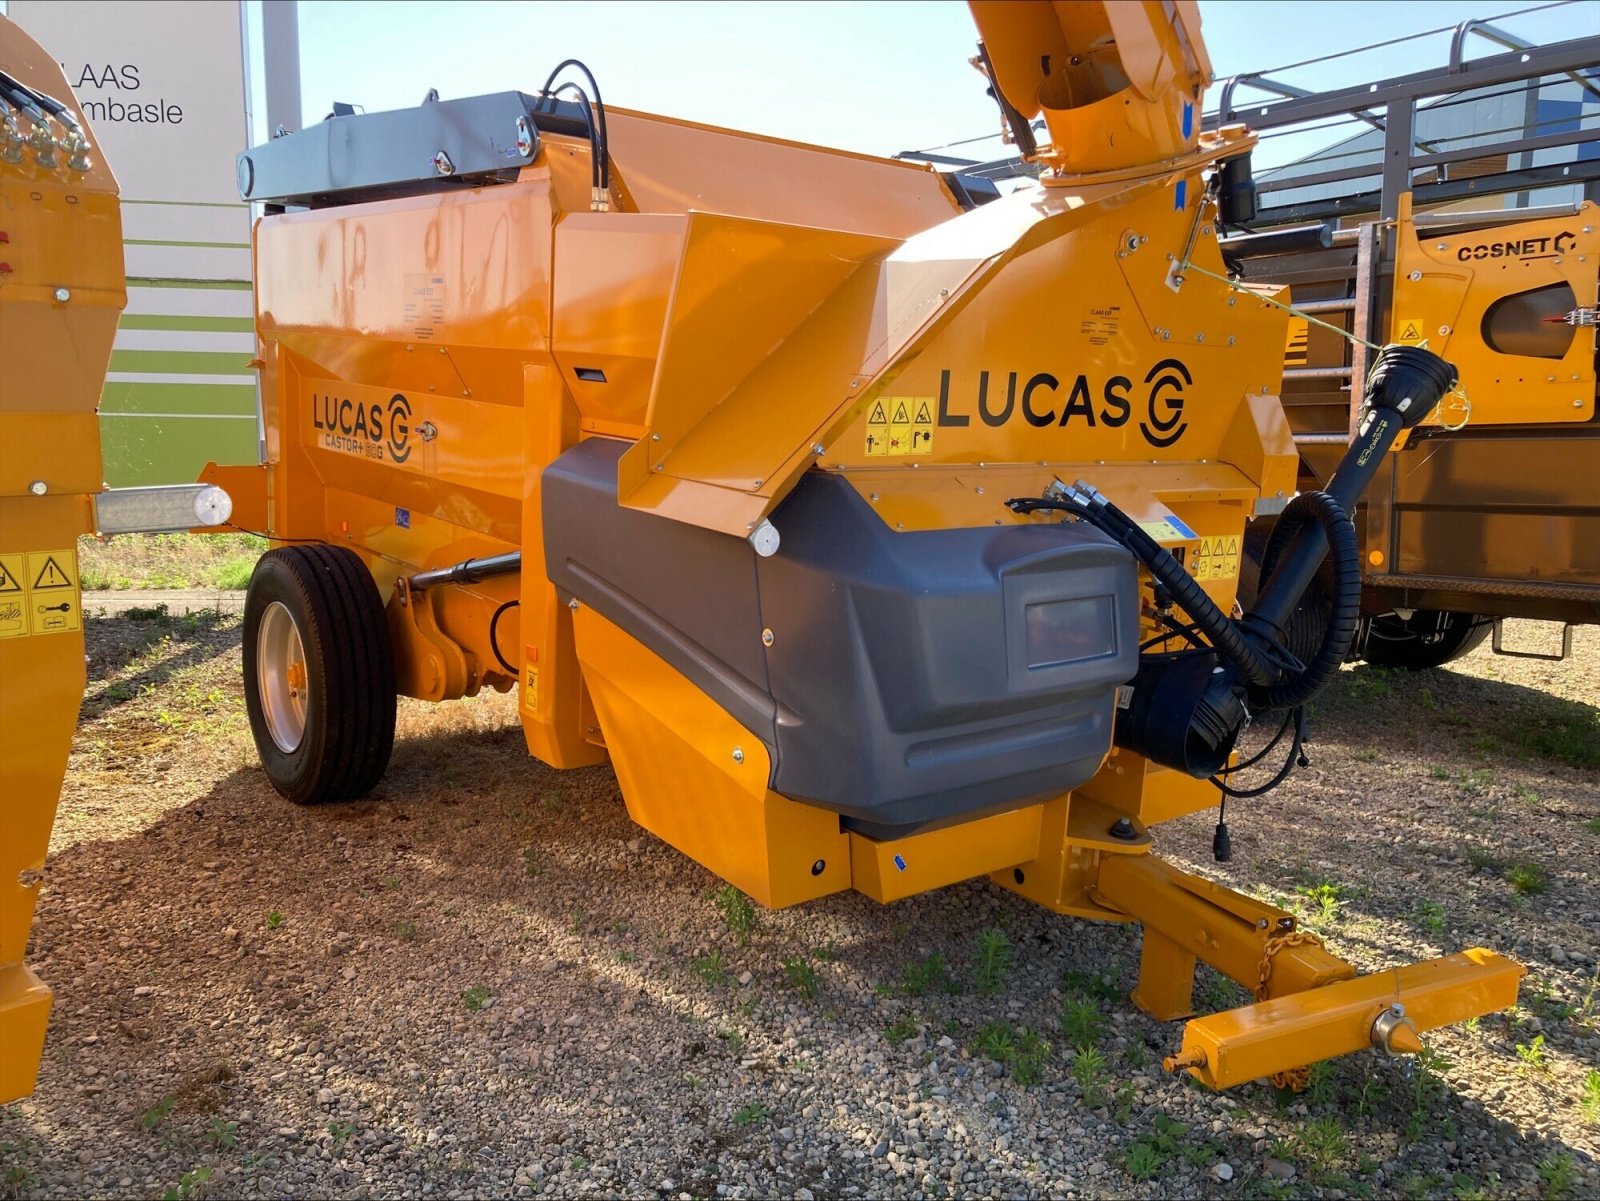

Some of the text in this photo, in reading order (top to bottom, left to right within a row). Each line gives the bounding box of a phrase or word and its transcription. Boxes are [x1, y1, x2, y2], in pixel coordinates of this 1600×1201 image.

[1457, 237, 1551, 262] COSNET
[938, 369, 1133, 428] LUCAS
[313, 393, 383, 442] LUCAS
[325, 433, 363, 455] CASTOR+
